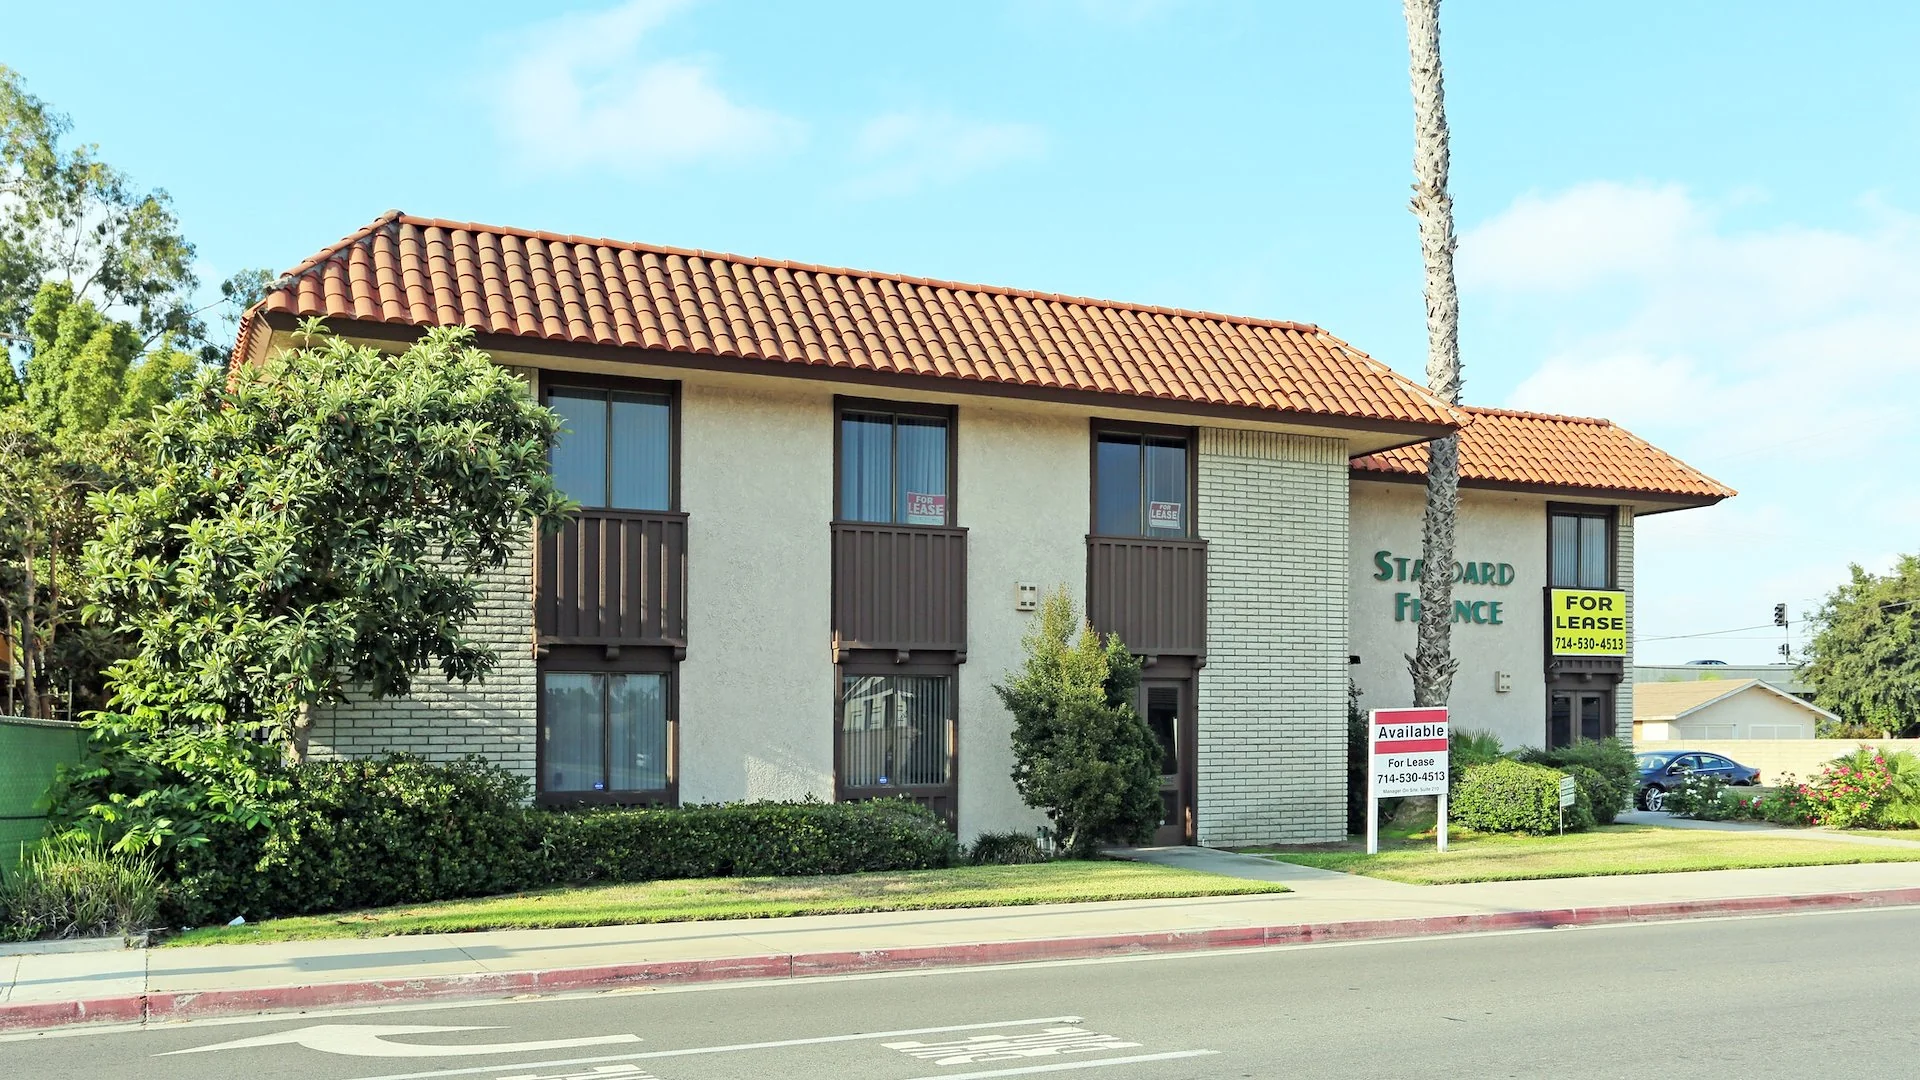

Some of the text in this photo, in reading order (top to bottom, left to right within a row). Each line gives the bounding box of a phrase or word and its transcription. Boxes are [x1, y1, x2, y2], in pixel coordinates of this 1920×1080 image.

[916, 495, 934, 504] FOR
[908, 502, 944, 516] LEASE
[1151, 509, 1178, 520] LEASE
[1373, 550, 1515, 586] STADARD
[1394, 592, 1504, 625] FINCE
[1566, 595, 1613, 611] FOR
[1556, 616, 1624, 630] LEASE
[1555, 637, 1624, 650] 714-530-4513
[1378, 724, 1444, 739] Available
[1388, 758, 1435, 768] For Lease
[1377, 771, 1445, 784] 714-530-4513
[880, 1026, 1143, 1066] BIKE
